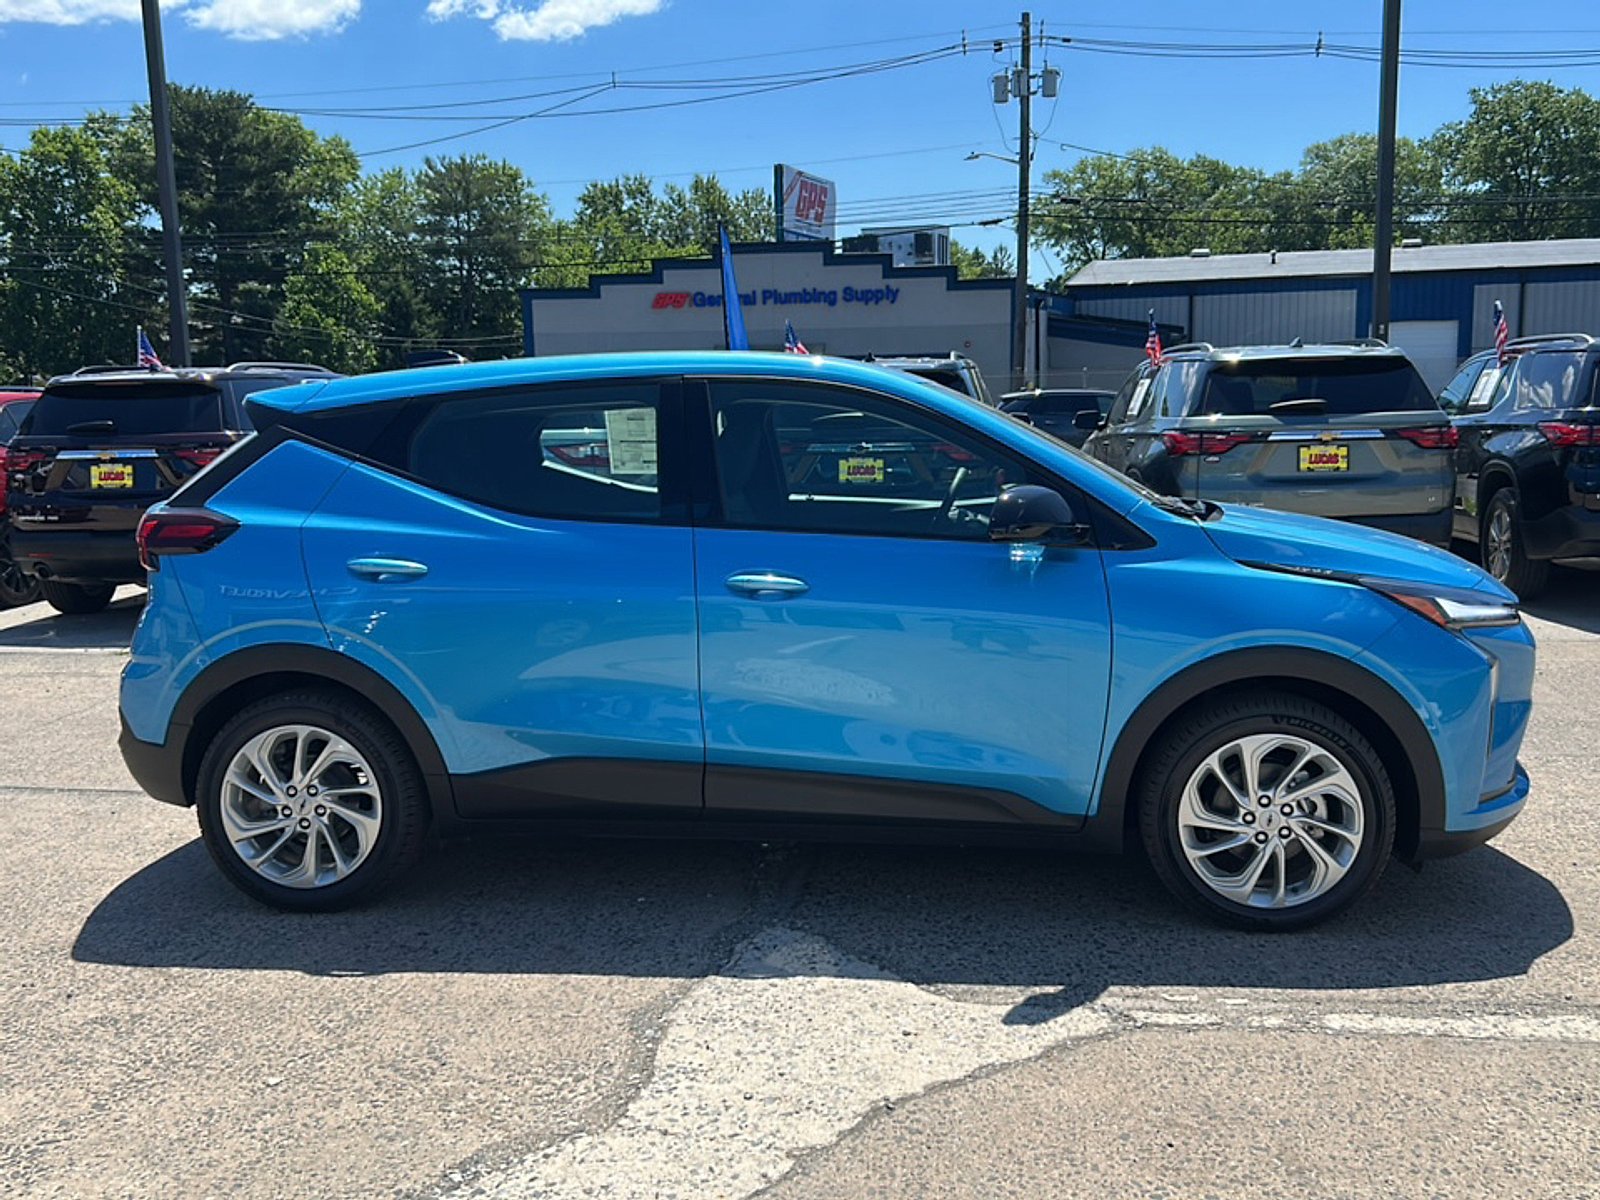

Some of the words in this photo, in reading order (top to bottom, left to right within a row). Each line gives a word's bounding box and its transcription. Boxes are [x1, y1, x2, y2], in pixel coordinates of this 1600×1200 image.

[795, 179, 828, 223] GPS
[652, 293, 689, 309] GPS
[693, 291, 757, 307] Genral
[761, 288, 838, 307] Plumbing
[842, 284, 899, 305] Supply
[1309, 453, 1339, 465] LUCAS
[98, 470, 126, 481] LUCAS
[847, 464, 877, 476] LUCAS
